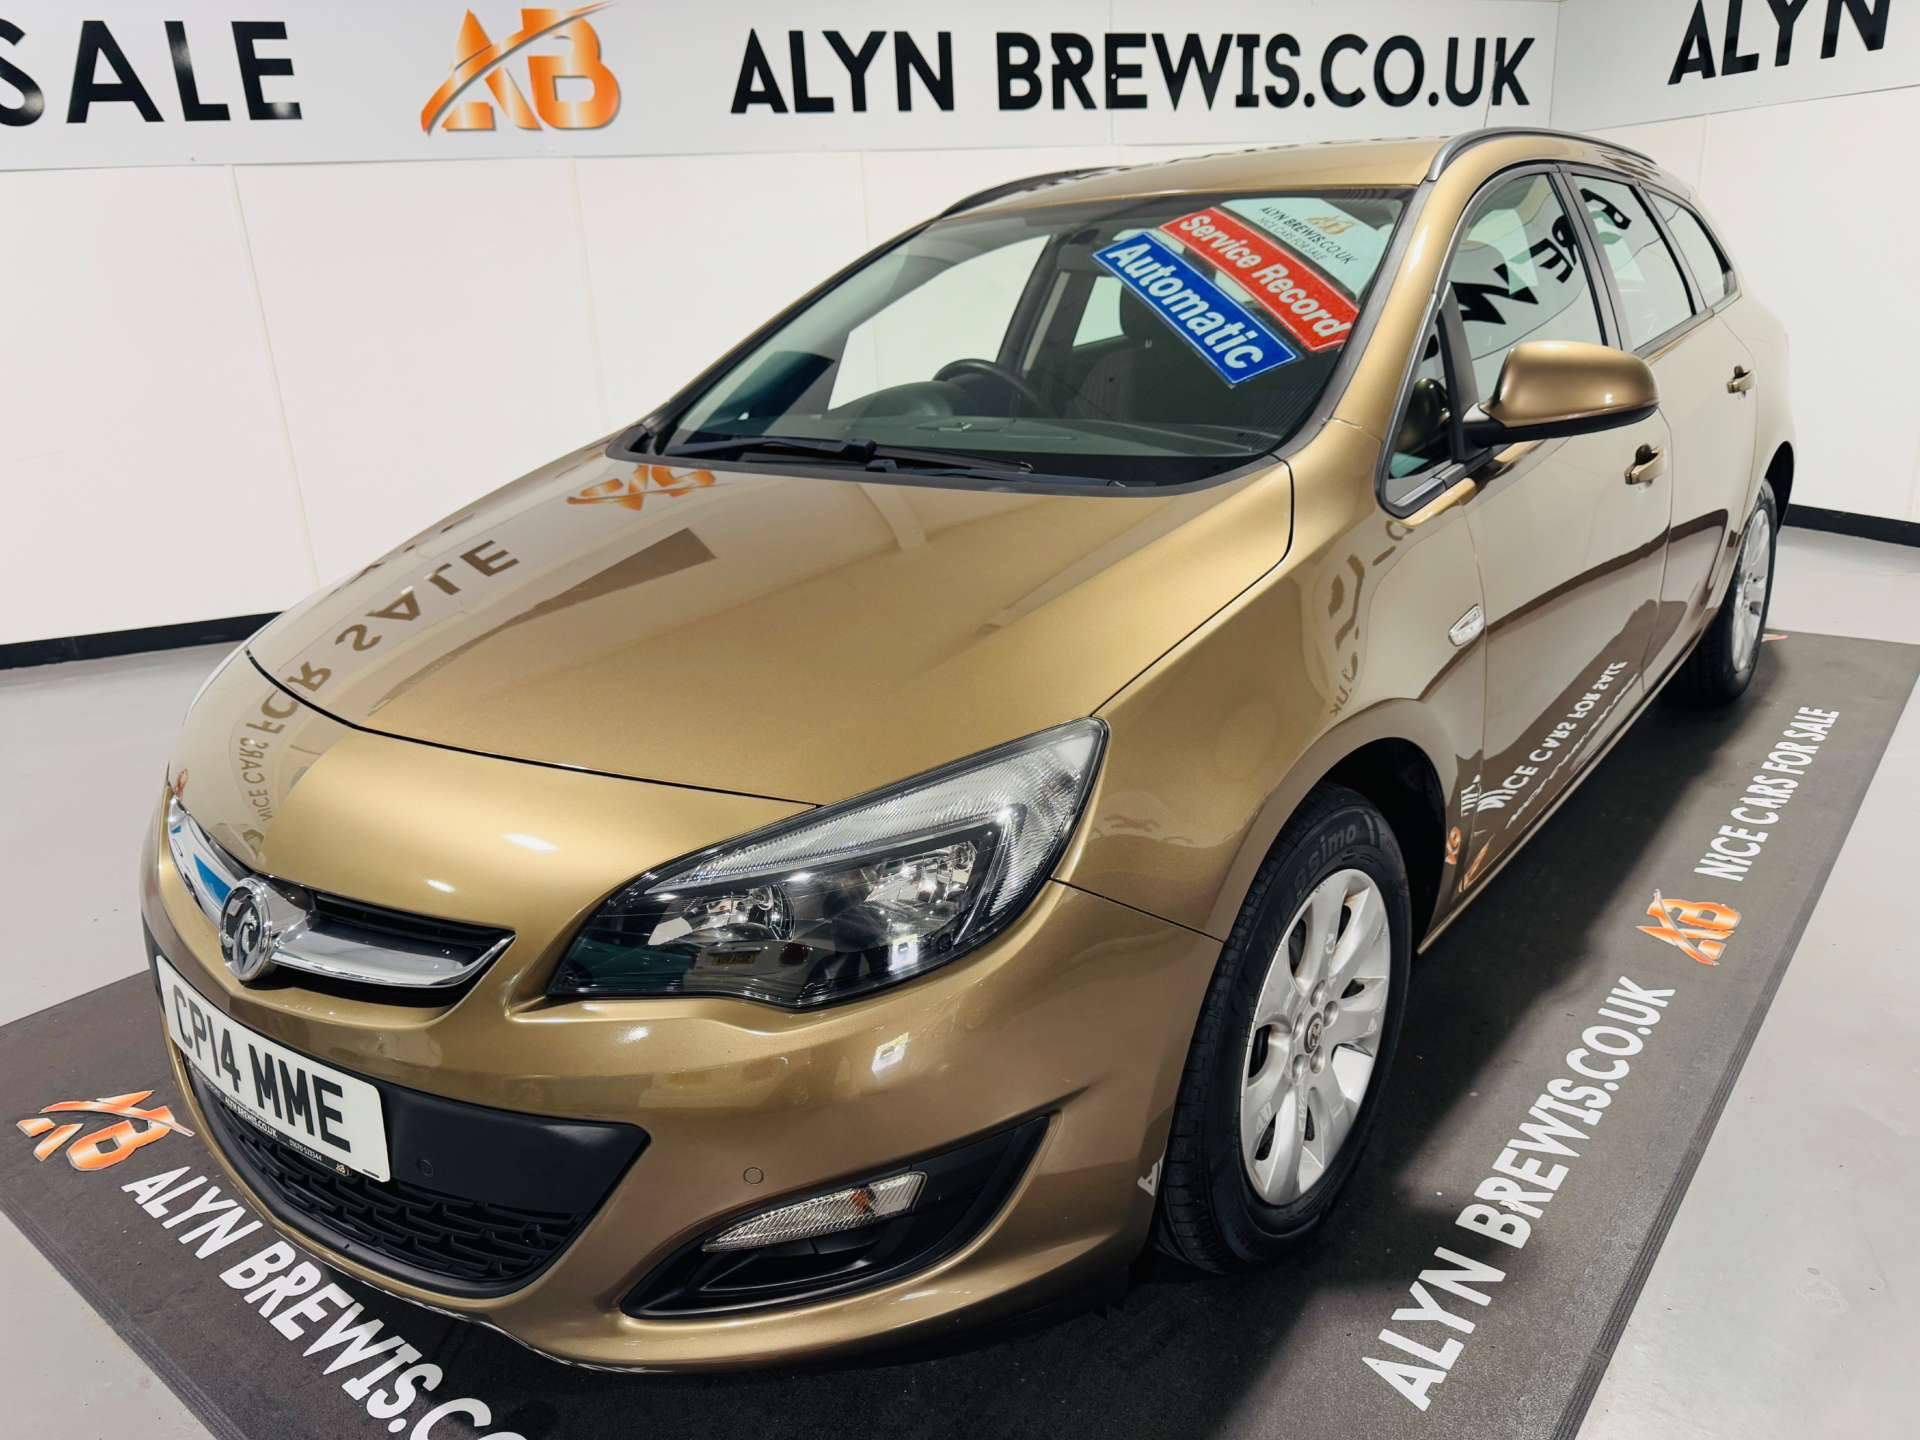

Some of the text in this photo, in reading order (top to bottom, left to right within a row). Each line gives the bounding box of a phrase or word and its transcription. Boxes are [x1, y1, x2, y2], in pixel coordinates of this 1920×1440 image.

[0, 18, 301, 126] SALE
[731, 28, 1535, 114] ALYN BREWIS.CO.UK
[1667, 0, 1891, 85] ALYN
[1107, 243, 1263, 369] Automatic
[1178, 215, 1351, 338] Service Record
[1694, 706, 1840, 881] NICE CARS FOR SALE
[173, 984, 352, 1153] CP14 MME
[1361, 976, 1676, 1411] ALYN BREWIS.CO.UK
[121, 1166, 527, 1440] ALYN BREWIS.C
